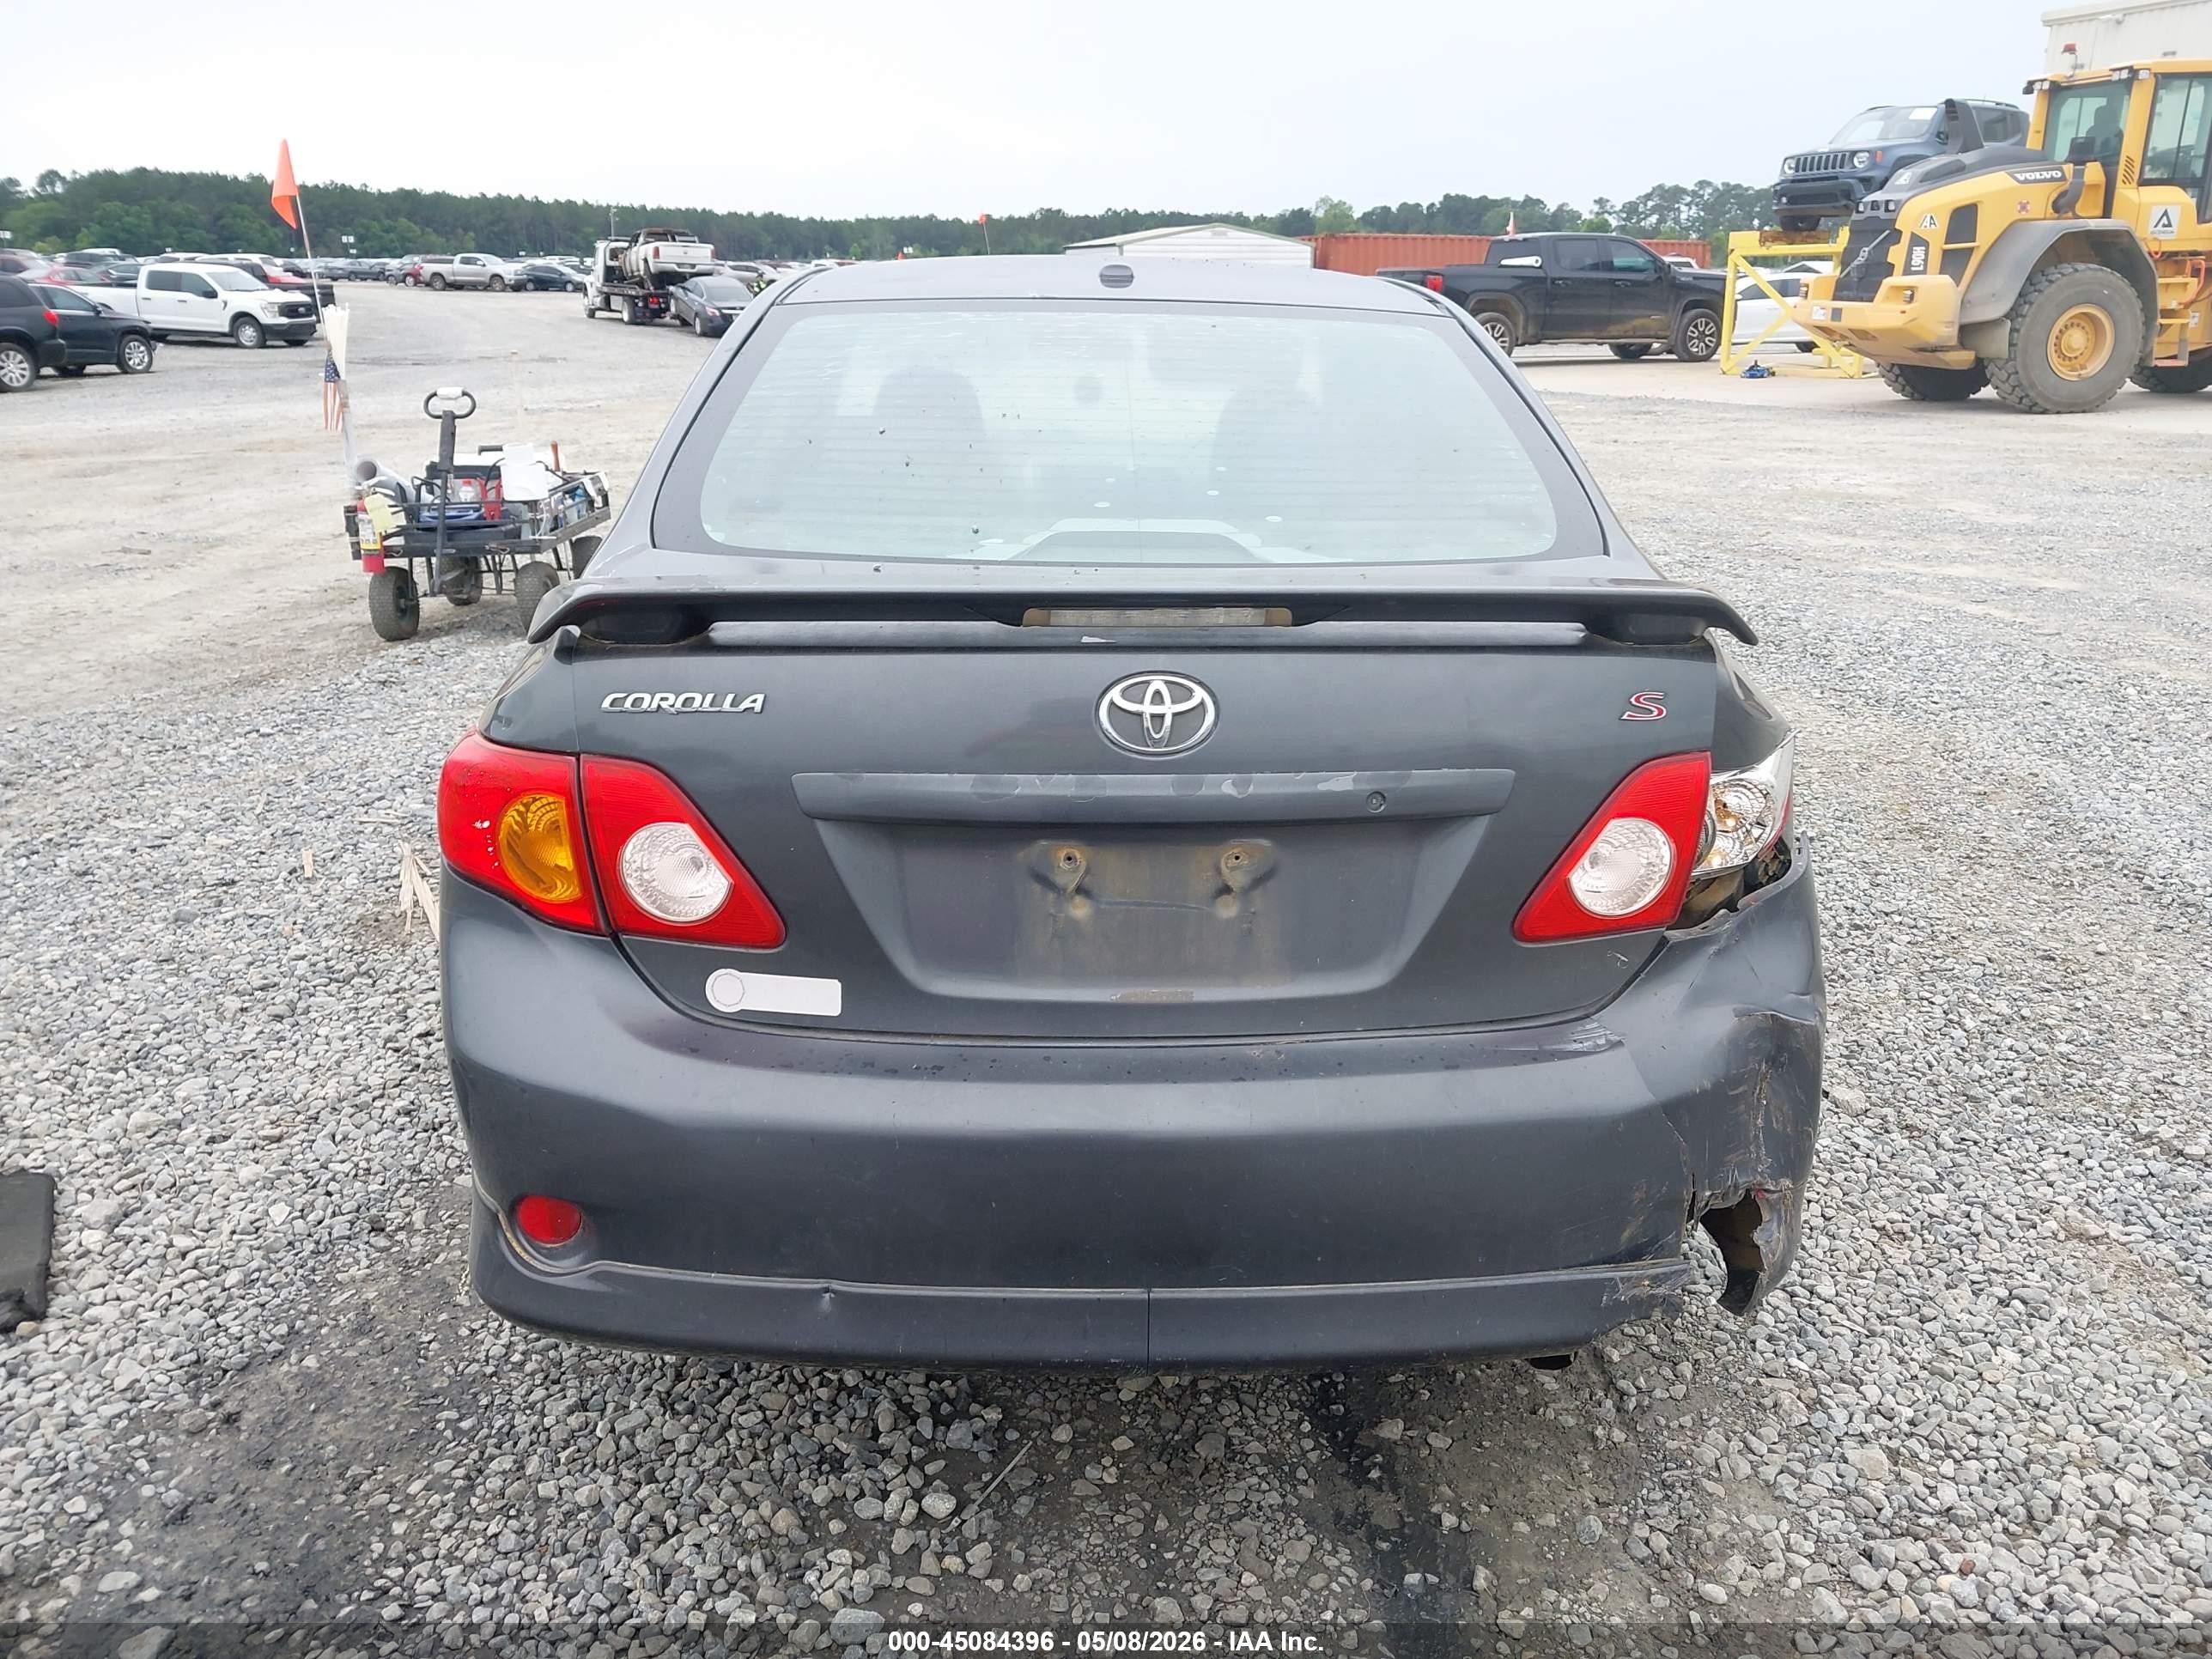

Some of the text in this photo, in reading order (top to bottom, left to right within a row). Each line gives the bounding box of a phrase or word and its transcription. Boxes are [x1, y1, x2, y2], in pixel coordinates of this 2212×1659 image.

[2014, 170, 2063, 181] VOLVO
[1911, 246, 1926, 271] L90H
[601, 692, 766, 714] COROLLA
[1620, 690, 1668, 721] S
